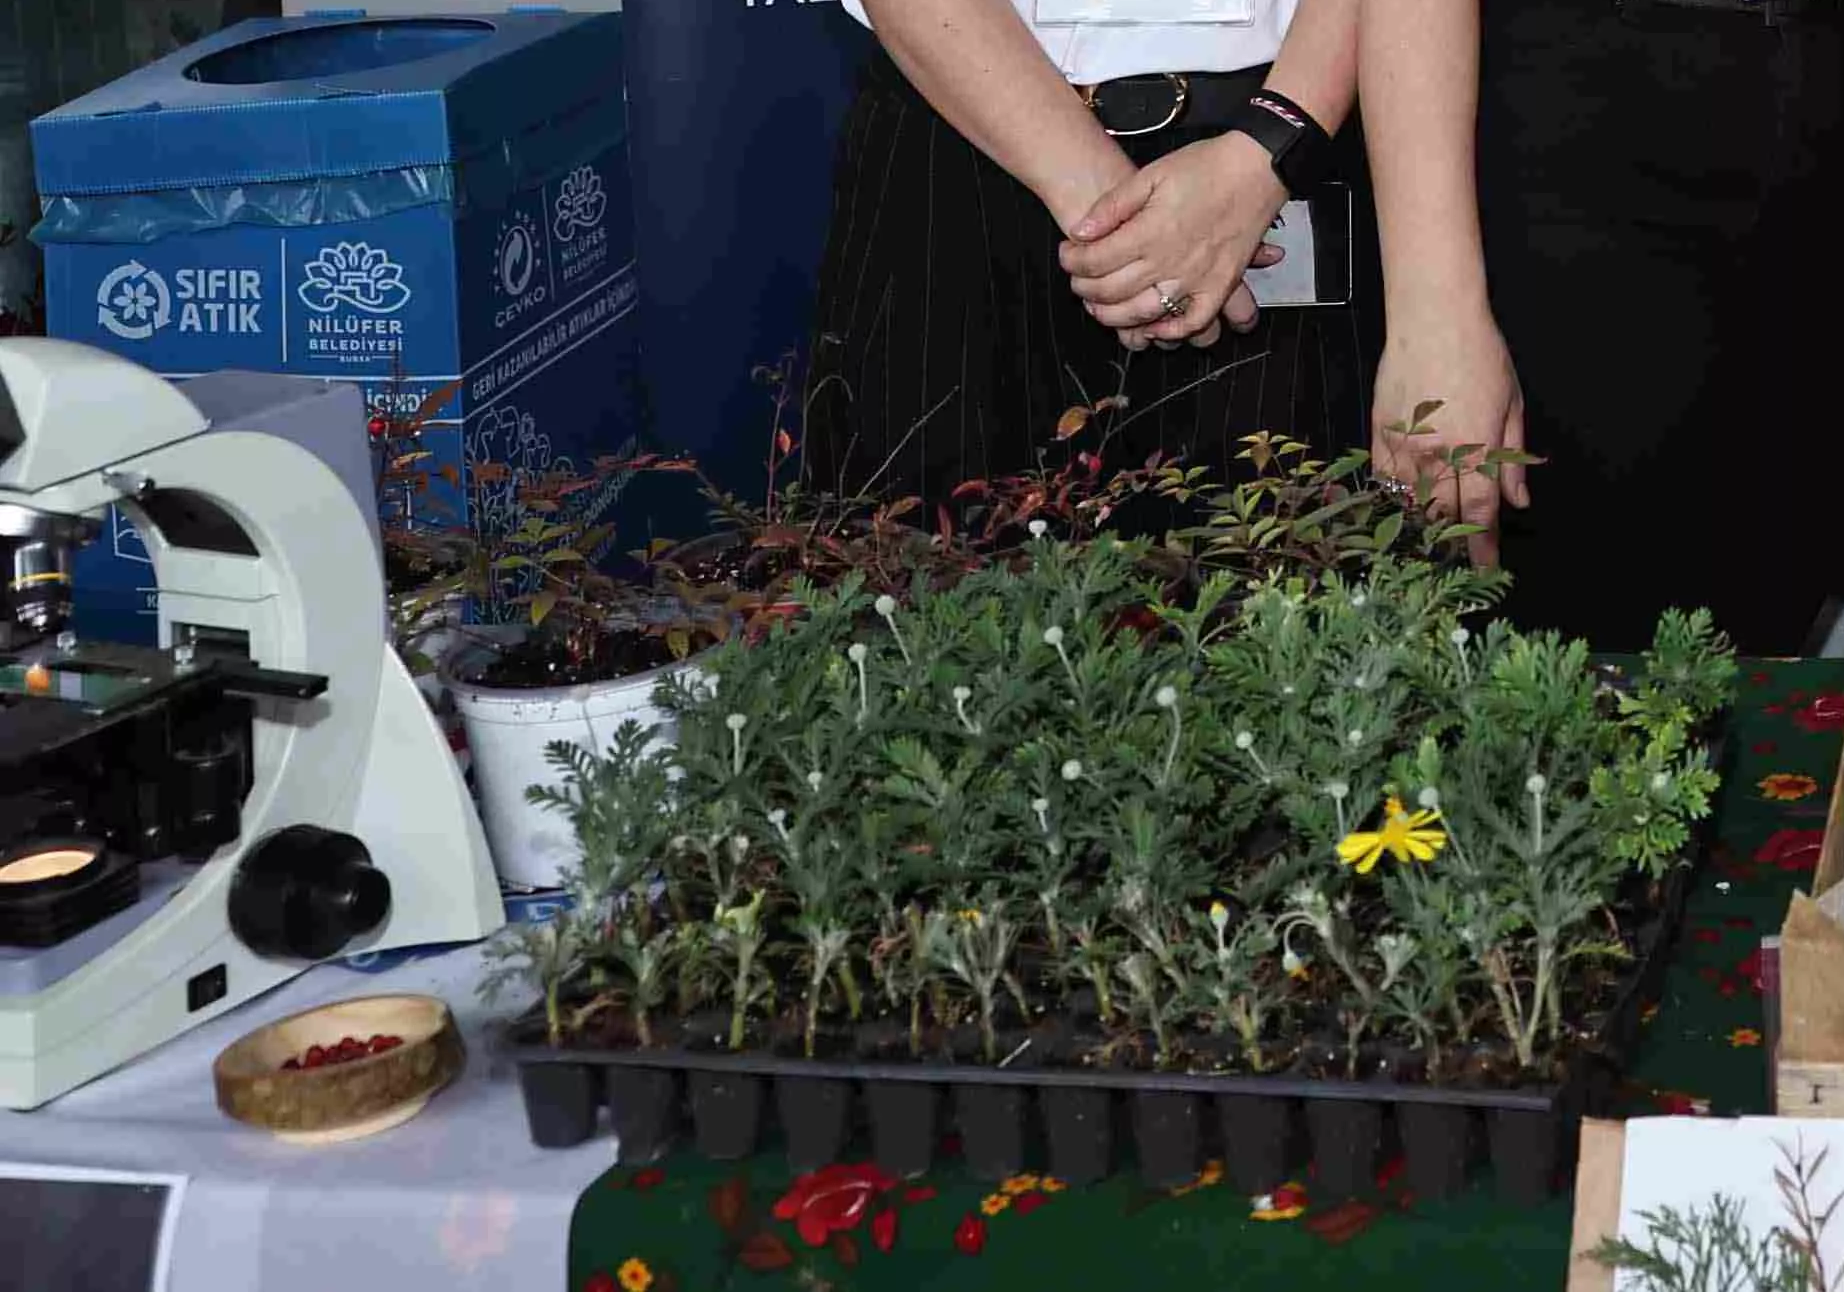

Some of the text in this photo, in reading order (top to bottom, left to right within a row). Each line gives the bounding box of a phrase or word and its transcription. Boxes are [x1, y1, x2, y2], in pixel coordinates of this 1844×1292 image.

[176, 269, 262, 300] SIFIR
[179, 303, 262, 333] ATIK
[309, 315, 403, 335] NİLÜFER
[309, 336, 403, 352] BELEDİYESİ
